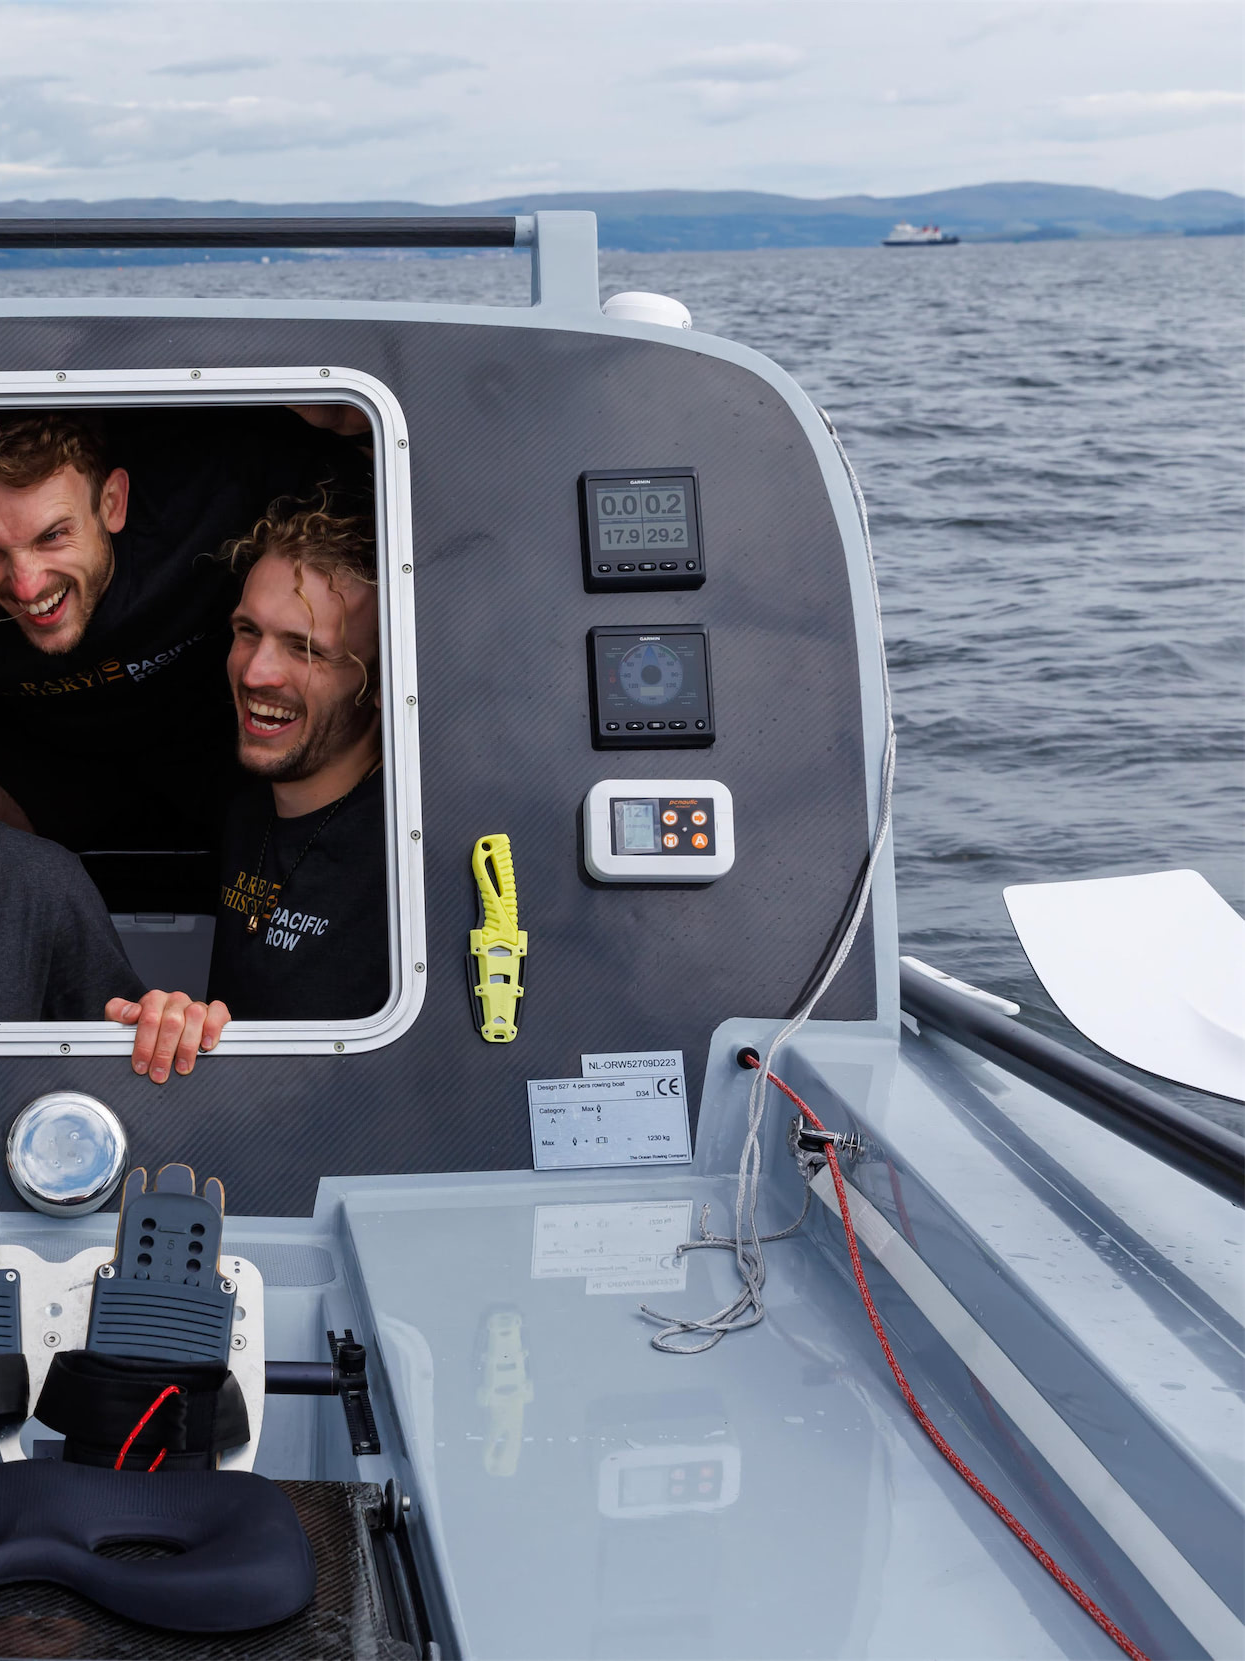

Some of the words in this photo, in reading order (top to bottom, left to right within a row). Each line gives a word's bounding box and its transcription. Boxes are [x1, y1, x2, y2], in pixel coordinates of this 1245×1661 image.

[601, 495, 637, 516] 0.0
[645, 494, 682, 514] 0.2
[604, 529, 640, 545] 17.9
[647, 528, 684, 543] 29.2
[695, 836, 705, 846] A
[270, 907, 329, 936] PACIFIC
[265, 926, 301, 951] ROW
[588, 1058, 677, 1070] NL-ORW52709D223
[539, 1107, 566, 1115] Category
[662, 1134, 671, 1142] kg
[167, 1239, 175, 1250] 5
